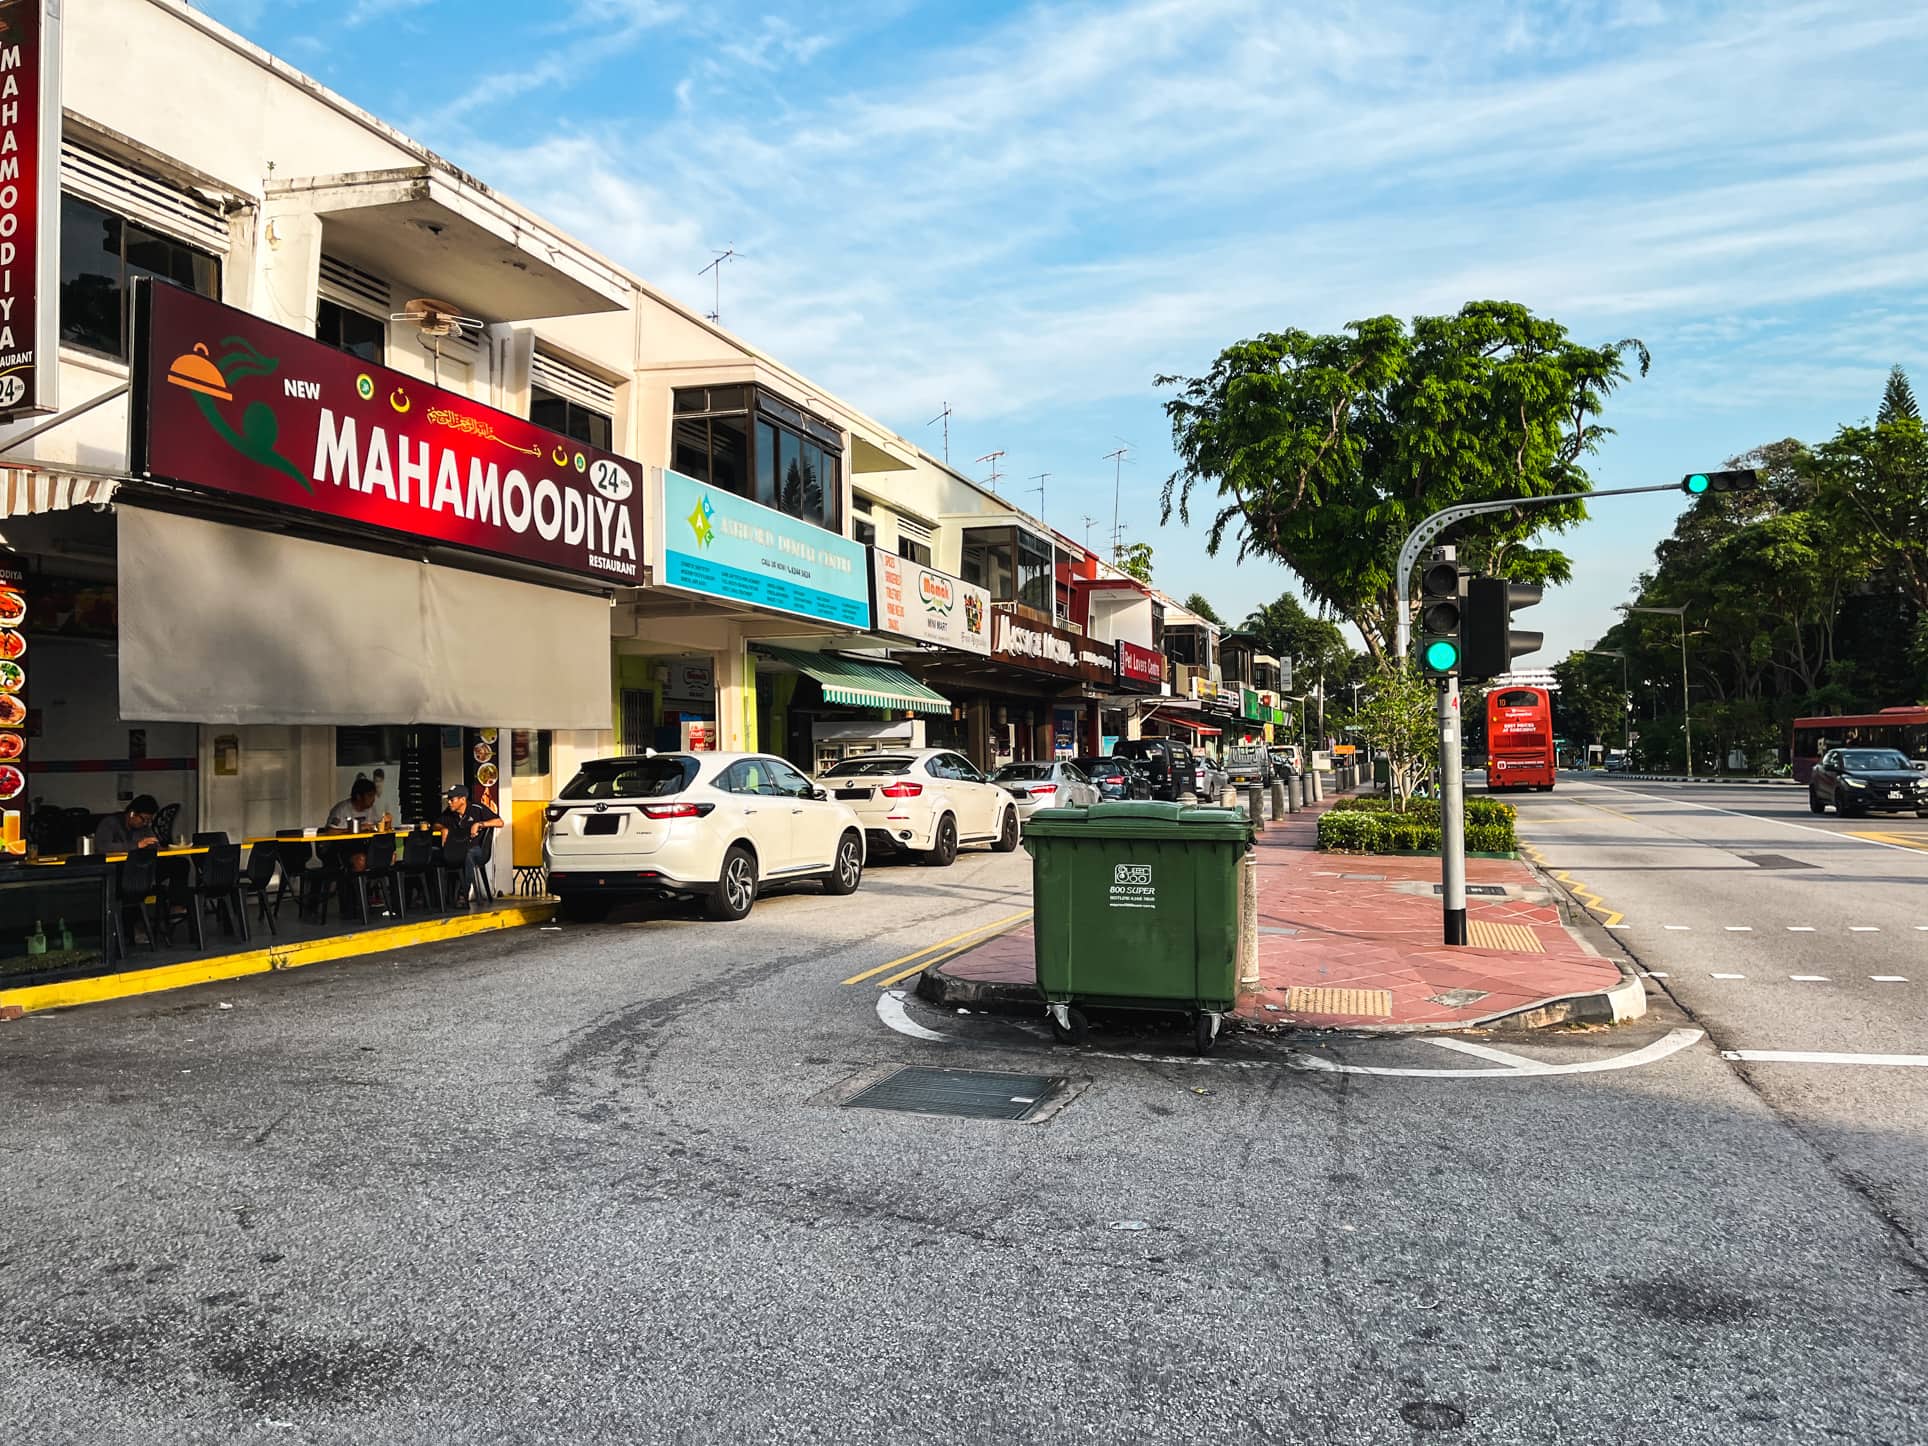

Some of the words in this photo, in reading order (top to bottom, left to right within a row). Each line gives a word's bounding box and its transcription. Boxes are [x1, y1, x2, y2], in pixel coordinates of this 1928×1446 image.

[284, 378, 320, 400] NEW
[313, 407, 637, 561] MAHAMOODIYA
[598, 462, 619, 494] 24
[588, 554, 637, 576] RESTAURANT
[1109, 886, 1125, 894] 800
[1126, 887, 1156, 895] SUPER
